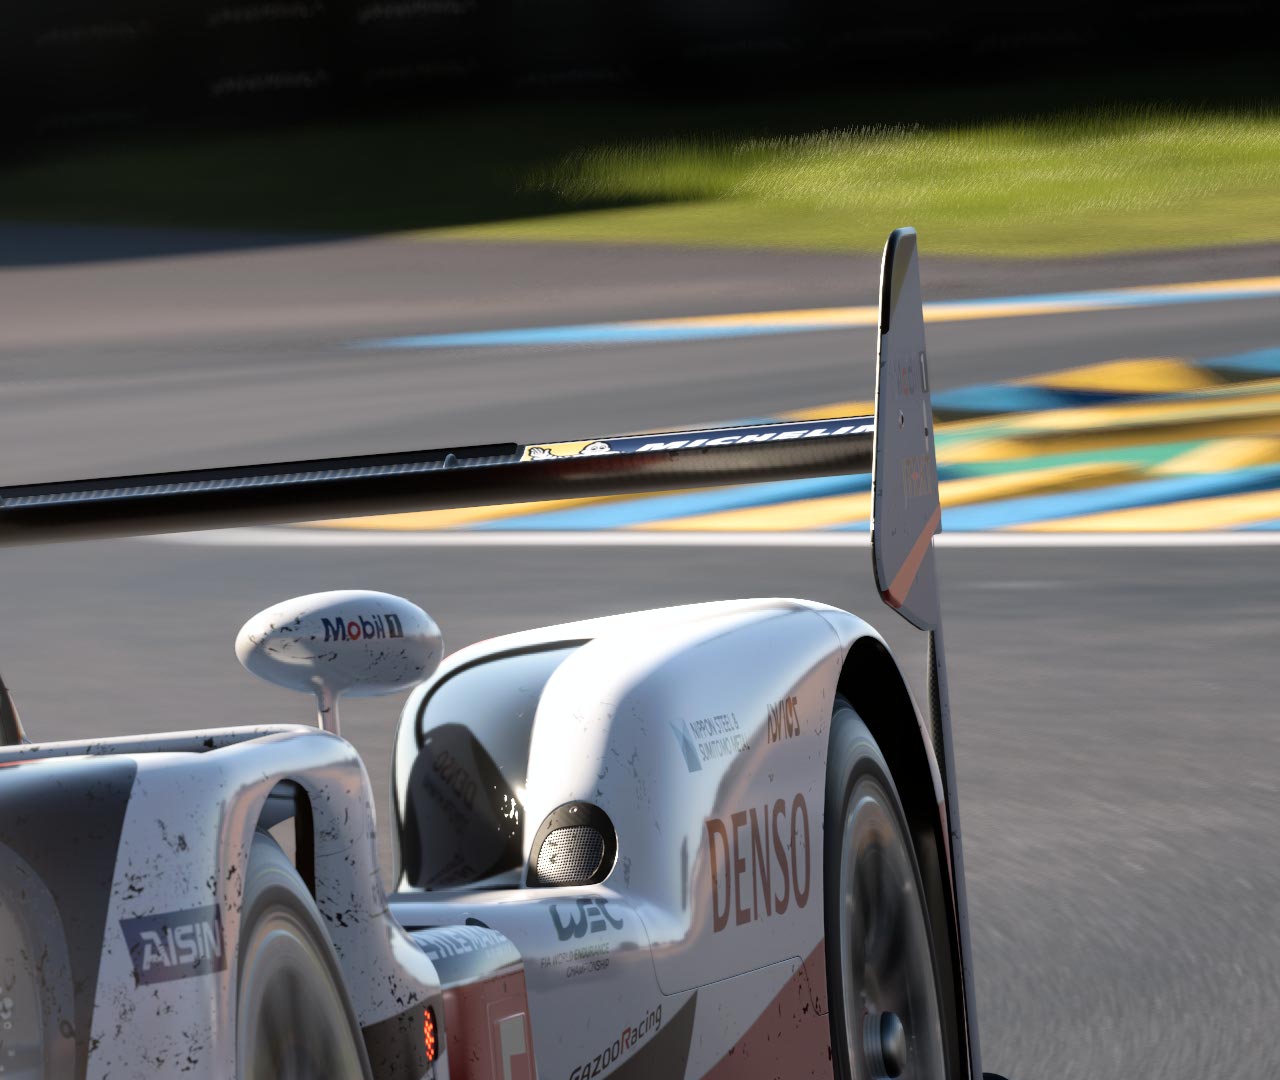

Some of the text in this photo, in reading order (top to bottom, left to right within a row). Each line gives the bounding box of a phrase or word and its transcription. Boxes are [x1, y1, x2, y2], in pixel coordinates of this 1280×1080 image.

[321, 615, 386, 642] Mobil
[706, 792, 811, 932] DENSO
[549, 898, 624, 941] WEC
[139, 922, 220, 970] AISIN
